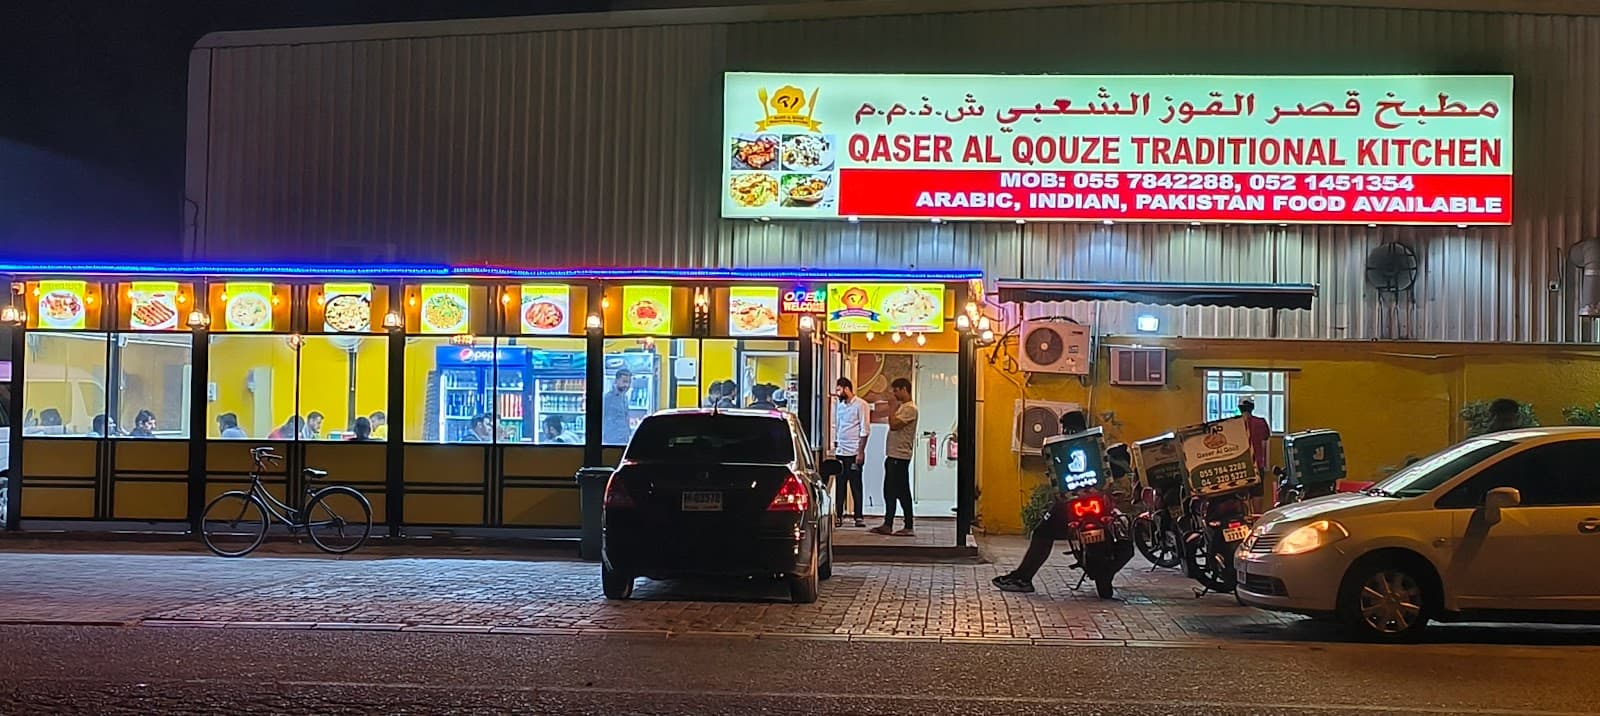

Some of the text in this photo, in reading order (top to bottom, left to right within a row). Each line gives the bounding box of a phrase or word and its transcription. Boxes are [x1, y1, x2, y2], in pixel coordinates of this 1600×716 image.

[996, 87, 1151, 133] الشعبي
[1158, 91, 1255, 124] القوز
[1264, 90, 1361, 124] قصر
[1373, 92, 1500, 130] مطبخ
[848, 134, 1501, 167] QASER AL QOUZE TRADITIONAL KITCHEN
[1000, 172, 1414, 193] MOB: 055 7842288, 052 1451354
[915, 192, 1502, 213] ARABIC, INDIAN, PAKISTAN FOOD AVAILABLE
[783, 301, 825, 312] WELCOME
[784, 291, 826, 302] OPEN
[1199, 469, 1213, 478] 055
